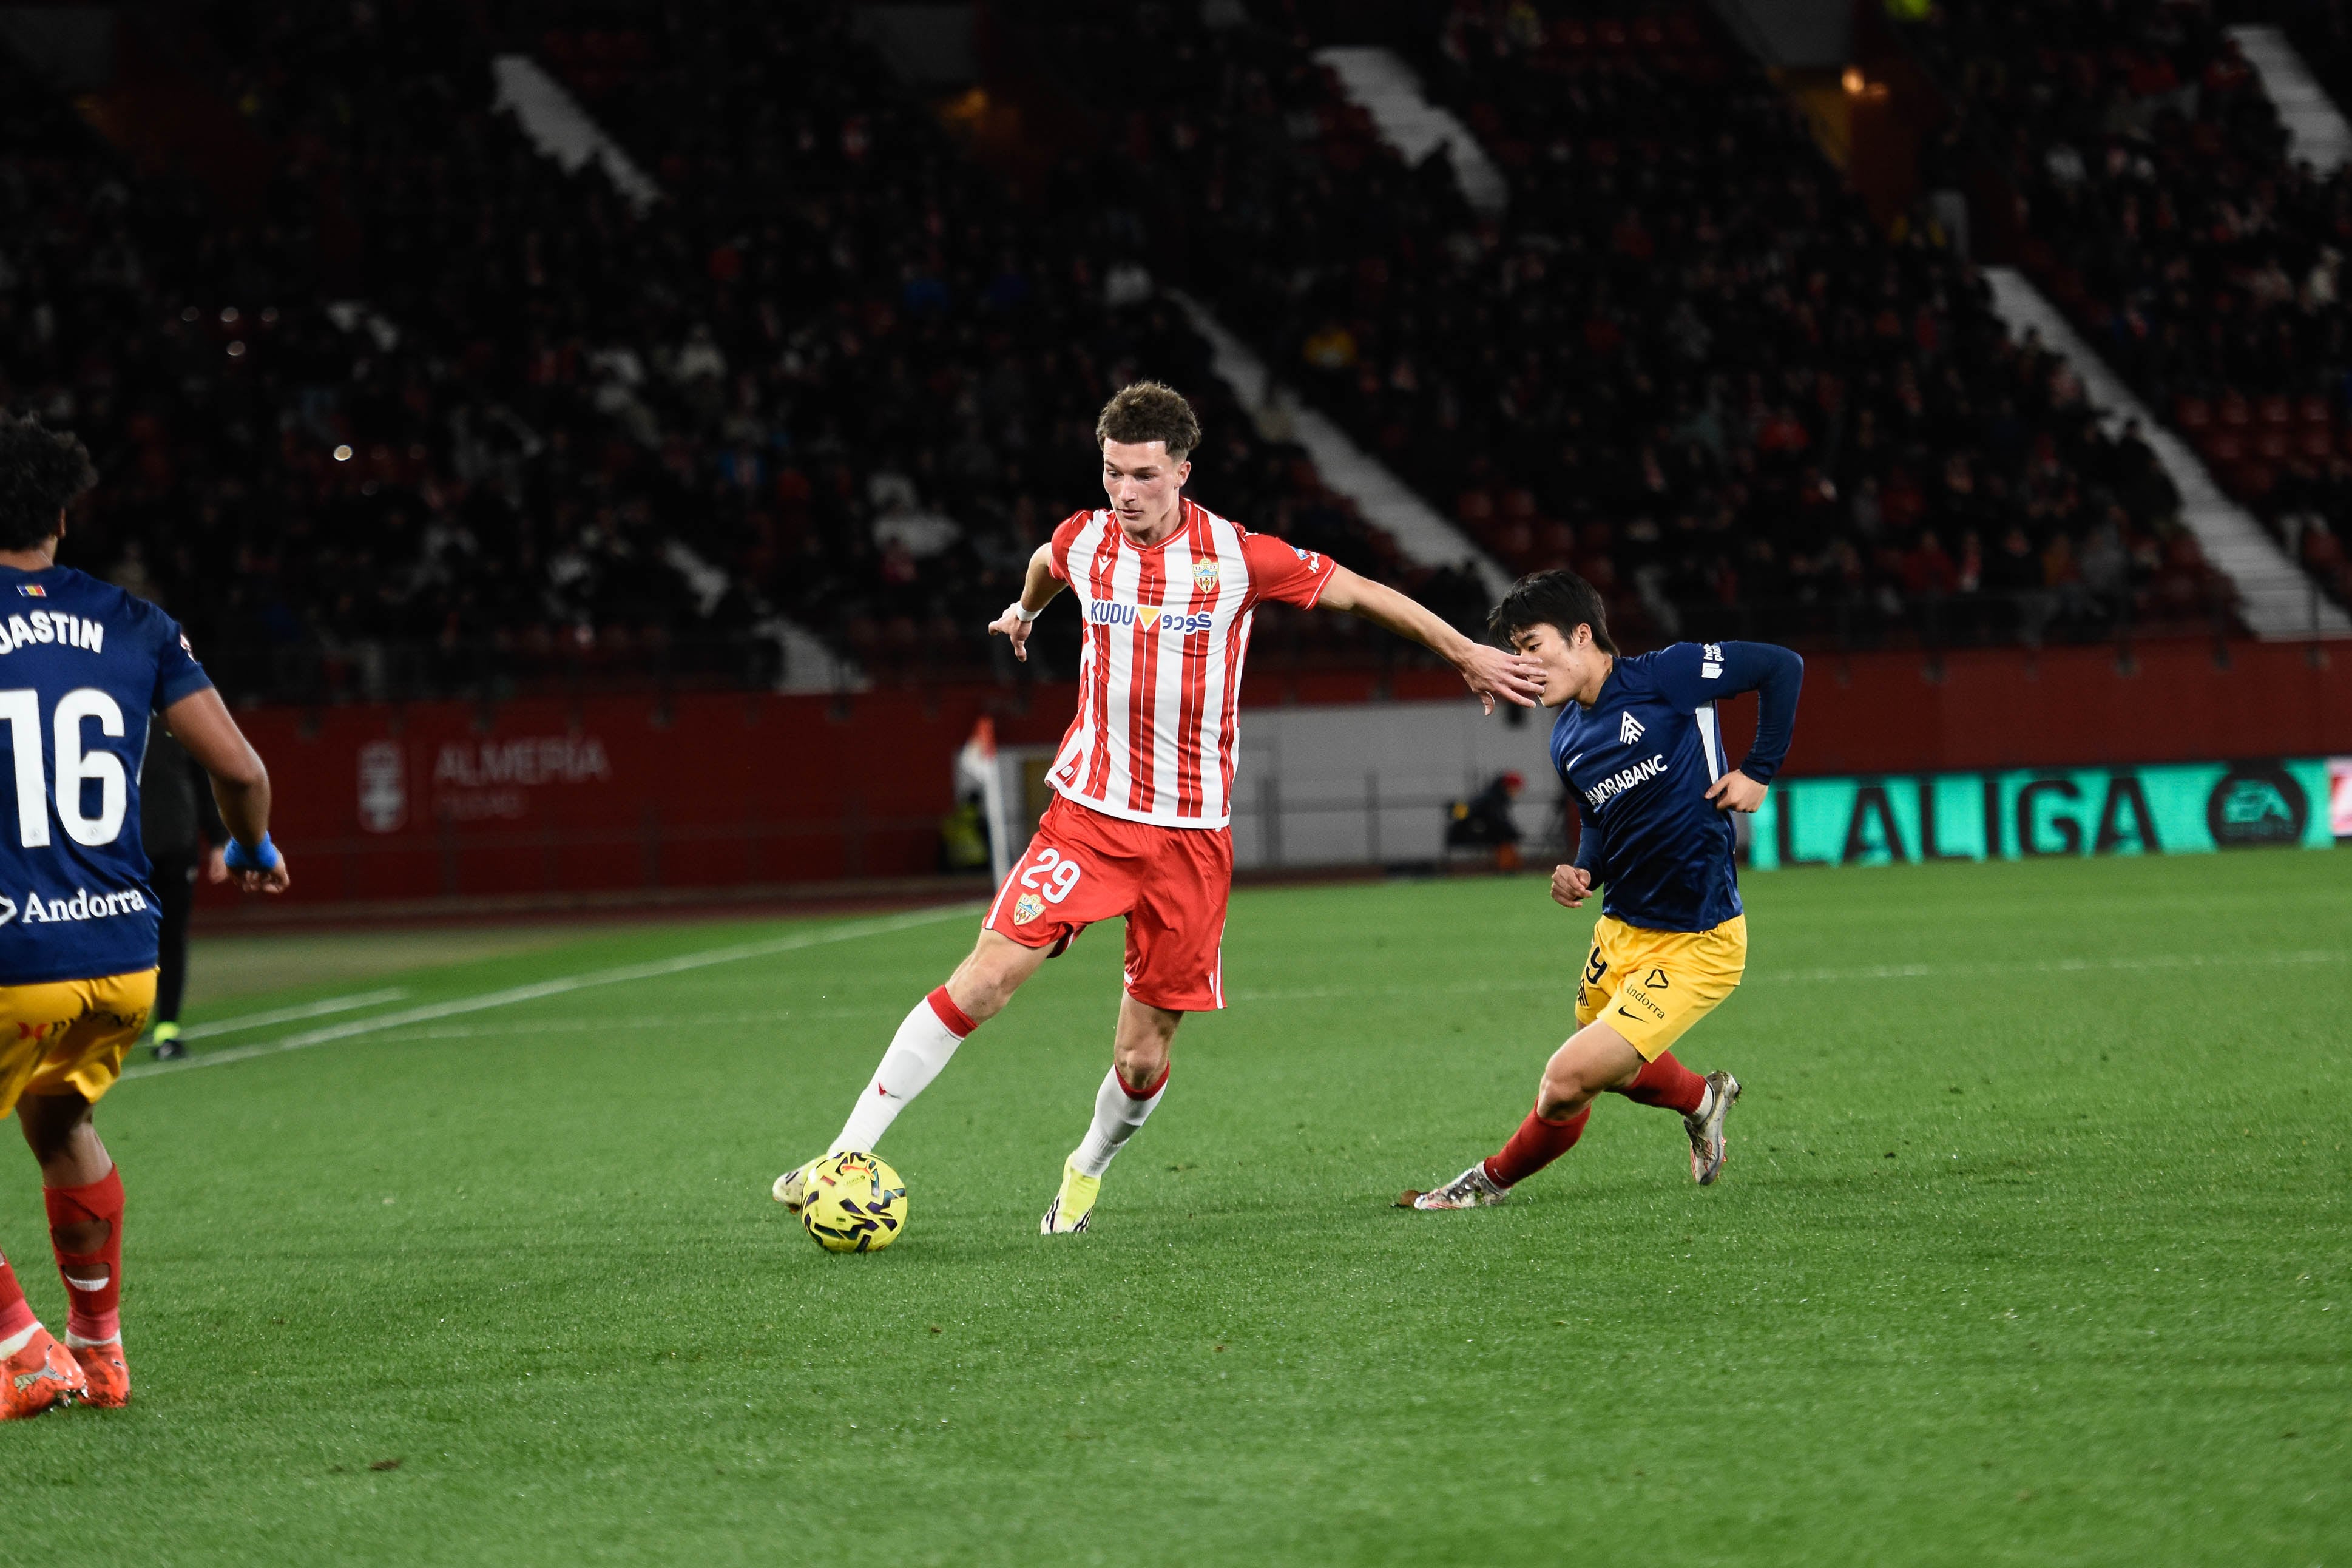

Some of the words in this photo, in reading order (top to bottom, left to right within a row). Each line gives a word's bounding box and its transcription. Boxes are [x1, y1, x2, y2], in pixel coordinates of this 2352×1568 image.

[1091, 601, 1135, 626] KUDU
[1162, 613, 1212, 633] كودو
[0, 688, 127, 848] 16
[1776, 777, 2163, 865] LALIGA
[1021, 848, 1080, 904] 29
[22, 888, 147, 923] Andorra
